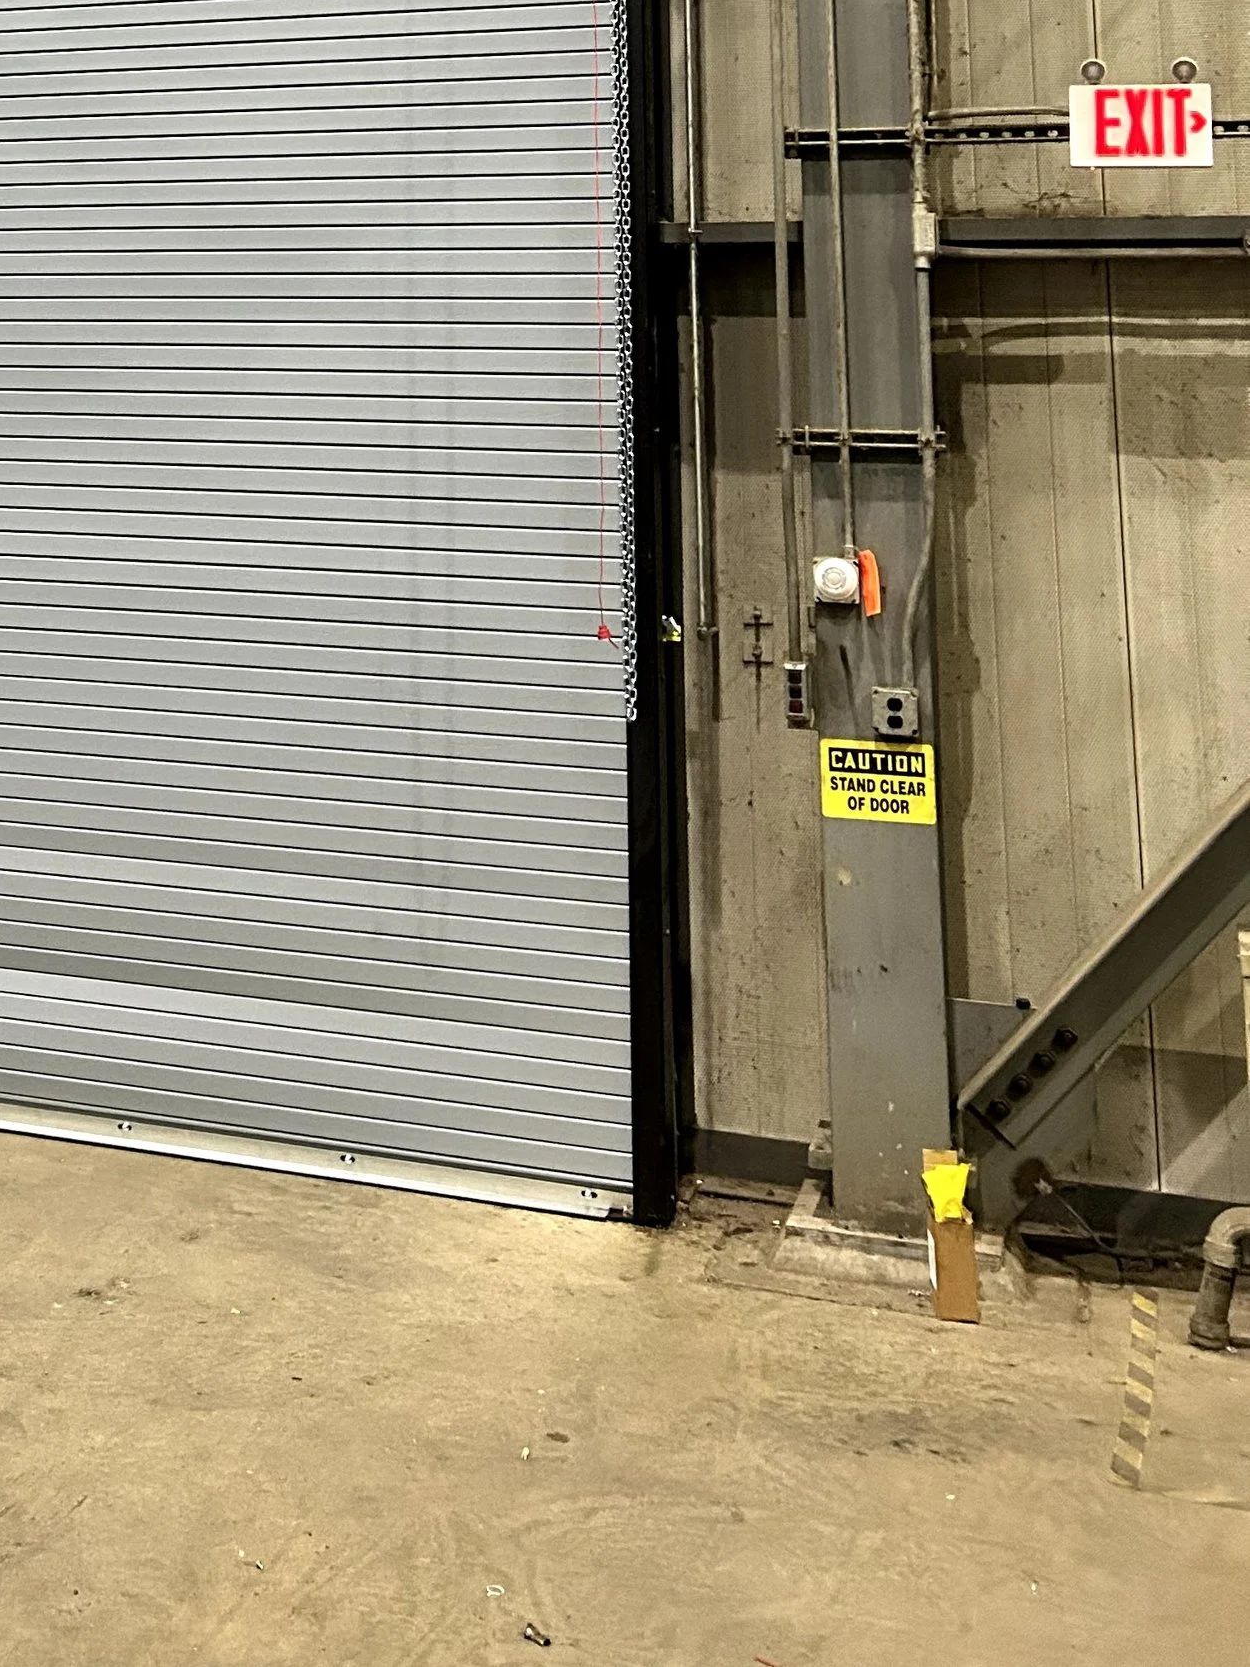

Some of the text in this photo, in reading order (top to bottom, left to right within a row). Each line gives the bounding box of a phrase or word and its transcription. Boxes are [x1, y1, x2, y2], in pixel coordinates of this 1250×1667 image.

[1094, 88, 1192, 157] EXIT
[830, 750, 924, 774] CAUTION
[830, 776, 926, 797] STAND CLEAR
[847, 796, 910, 814] OF DOOR
